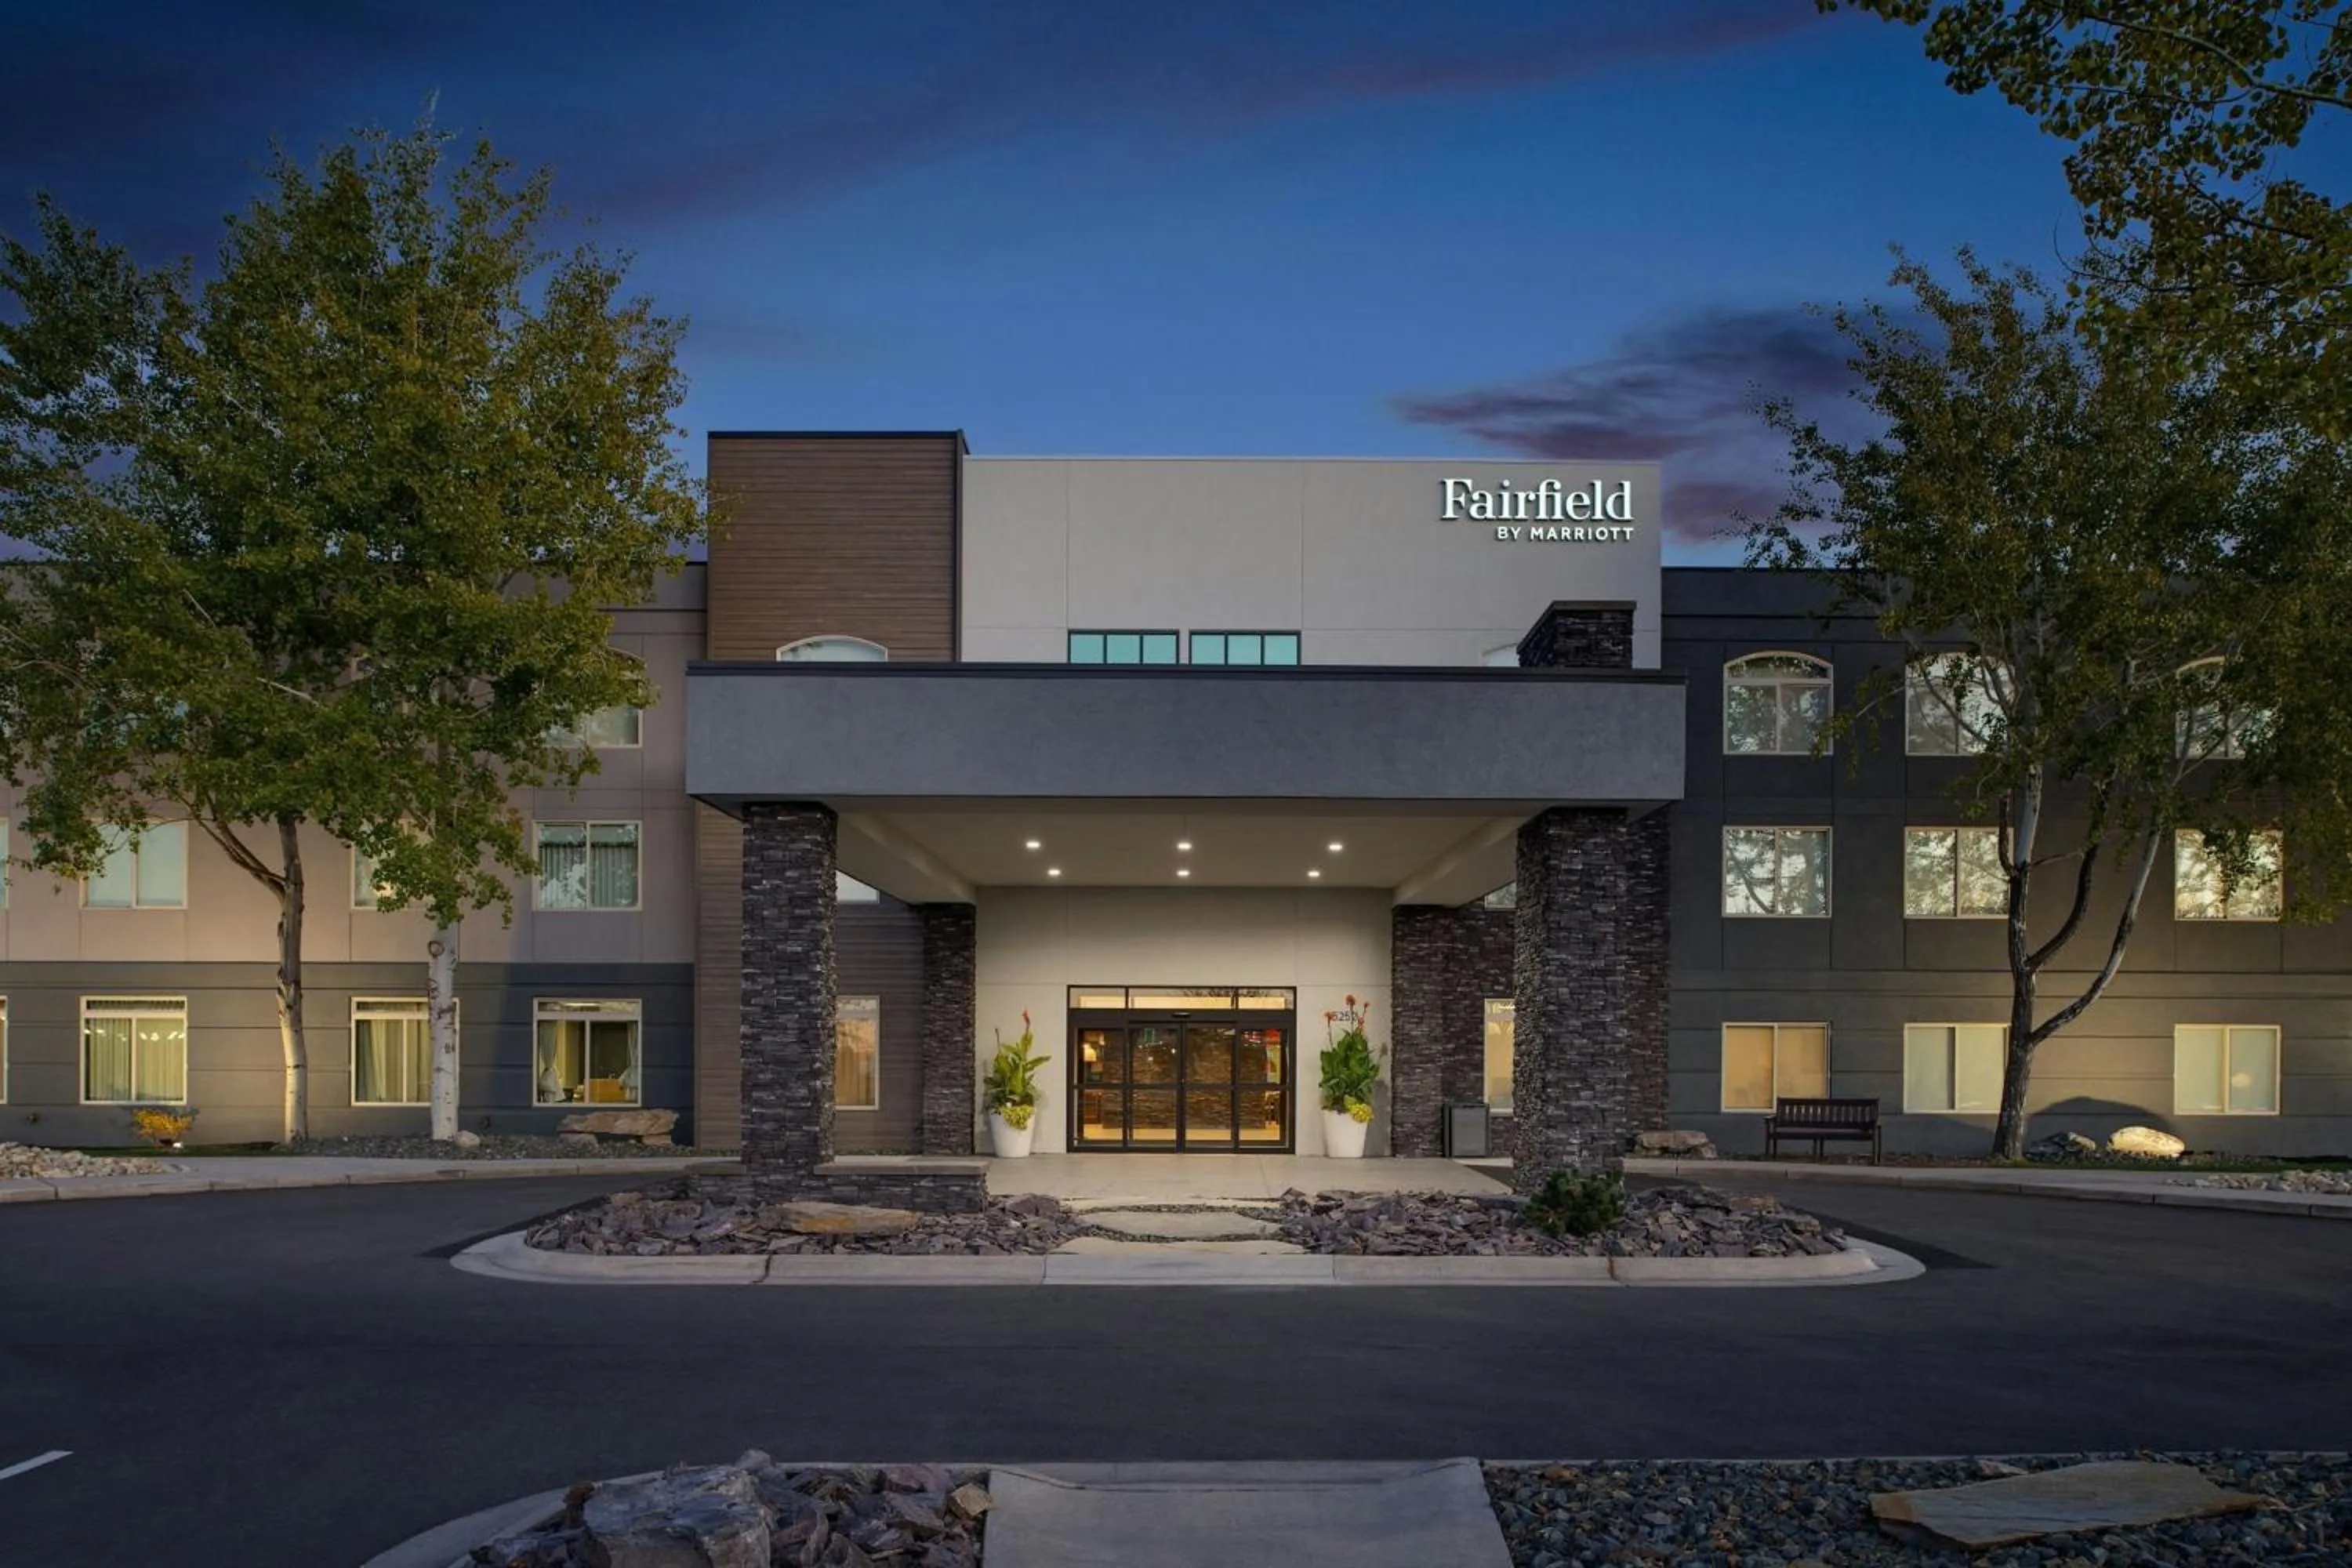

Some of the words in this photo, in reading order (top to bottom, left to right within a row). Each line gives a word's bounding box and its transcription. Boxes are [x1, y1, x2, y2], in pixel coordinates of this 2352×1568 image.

[1441, 478, 1635, 520] Fairfield
[1497, 526, 1522, 540] BY
[1530, 526, 1635, 541] MARRIOTT
